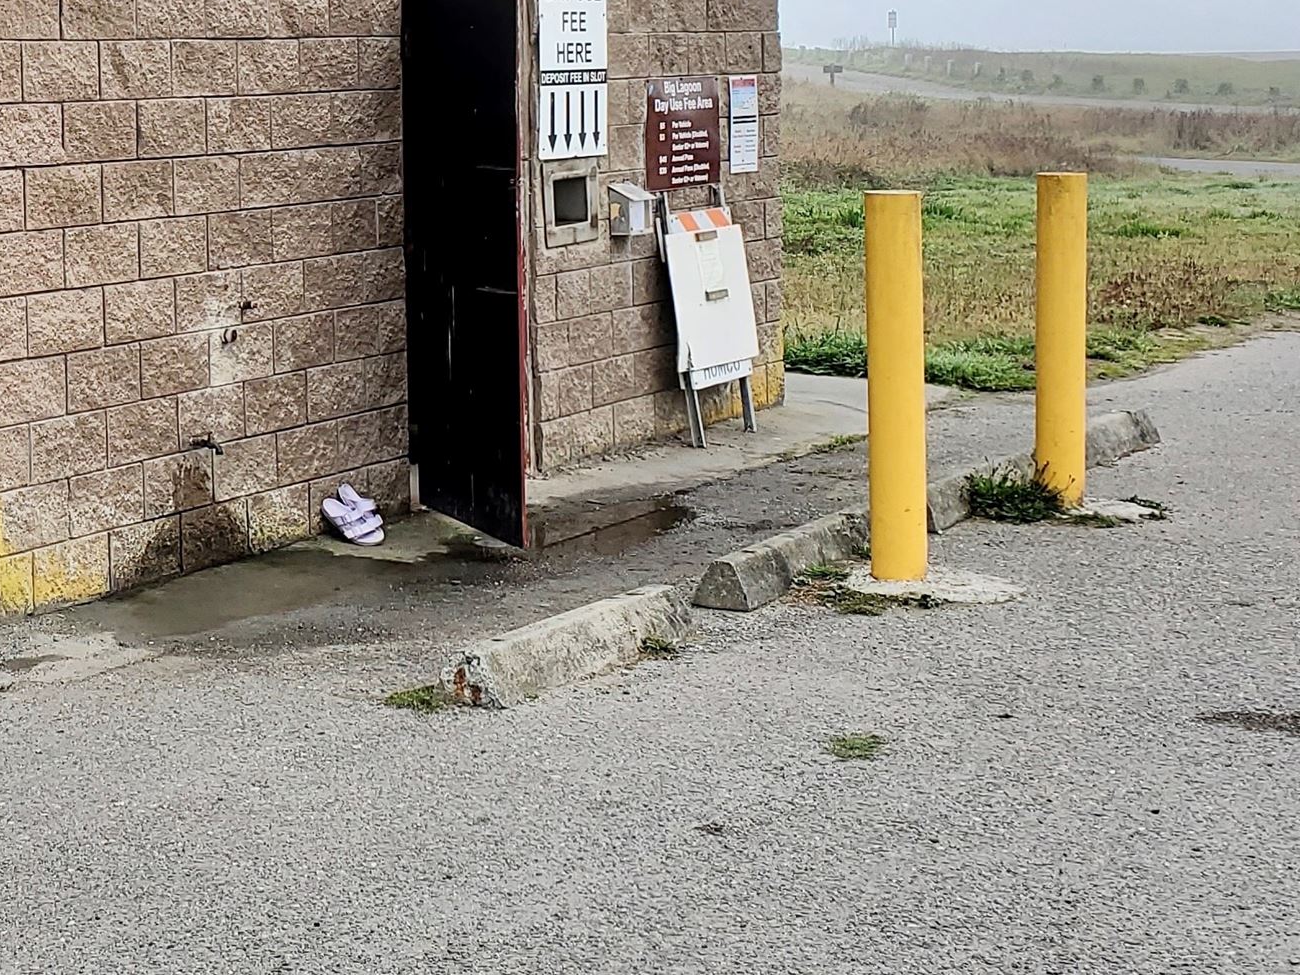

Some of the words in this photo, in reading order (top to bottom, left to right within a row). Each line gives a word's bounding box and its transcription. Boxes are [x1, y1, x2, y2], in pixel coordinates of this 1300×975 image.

[562, 11, 587, 32] FEE
[556, 42, 592, 63] HERE
[541, 72, 569, 84] DEPOSIT
[570, 72, 582, 83] FEE
[582, 71, 590, 83] IN
[590, 70, 606, 83] SLOT
[664, 81, 676, 97] Big
[676, 80, 702, 96] Lagoon
[655, 99, 669, 115] Day
[669, 97, 683, 111] Use
[683, 96, 697, 110] Fee
[697, 95, 713, 109] Area
